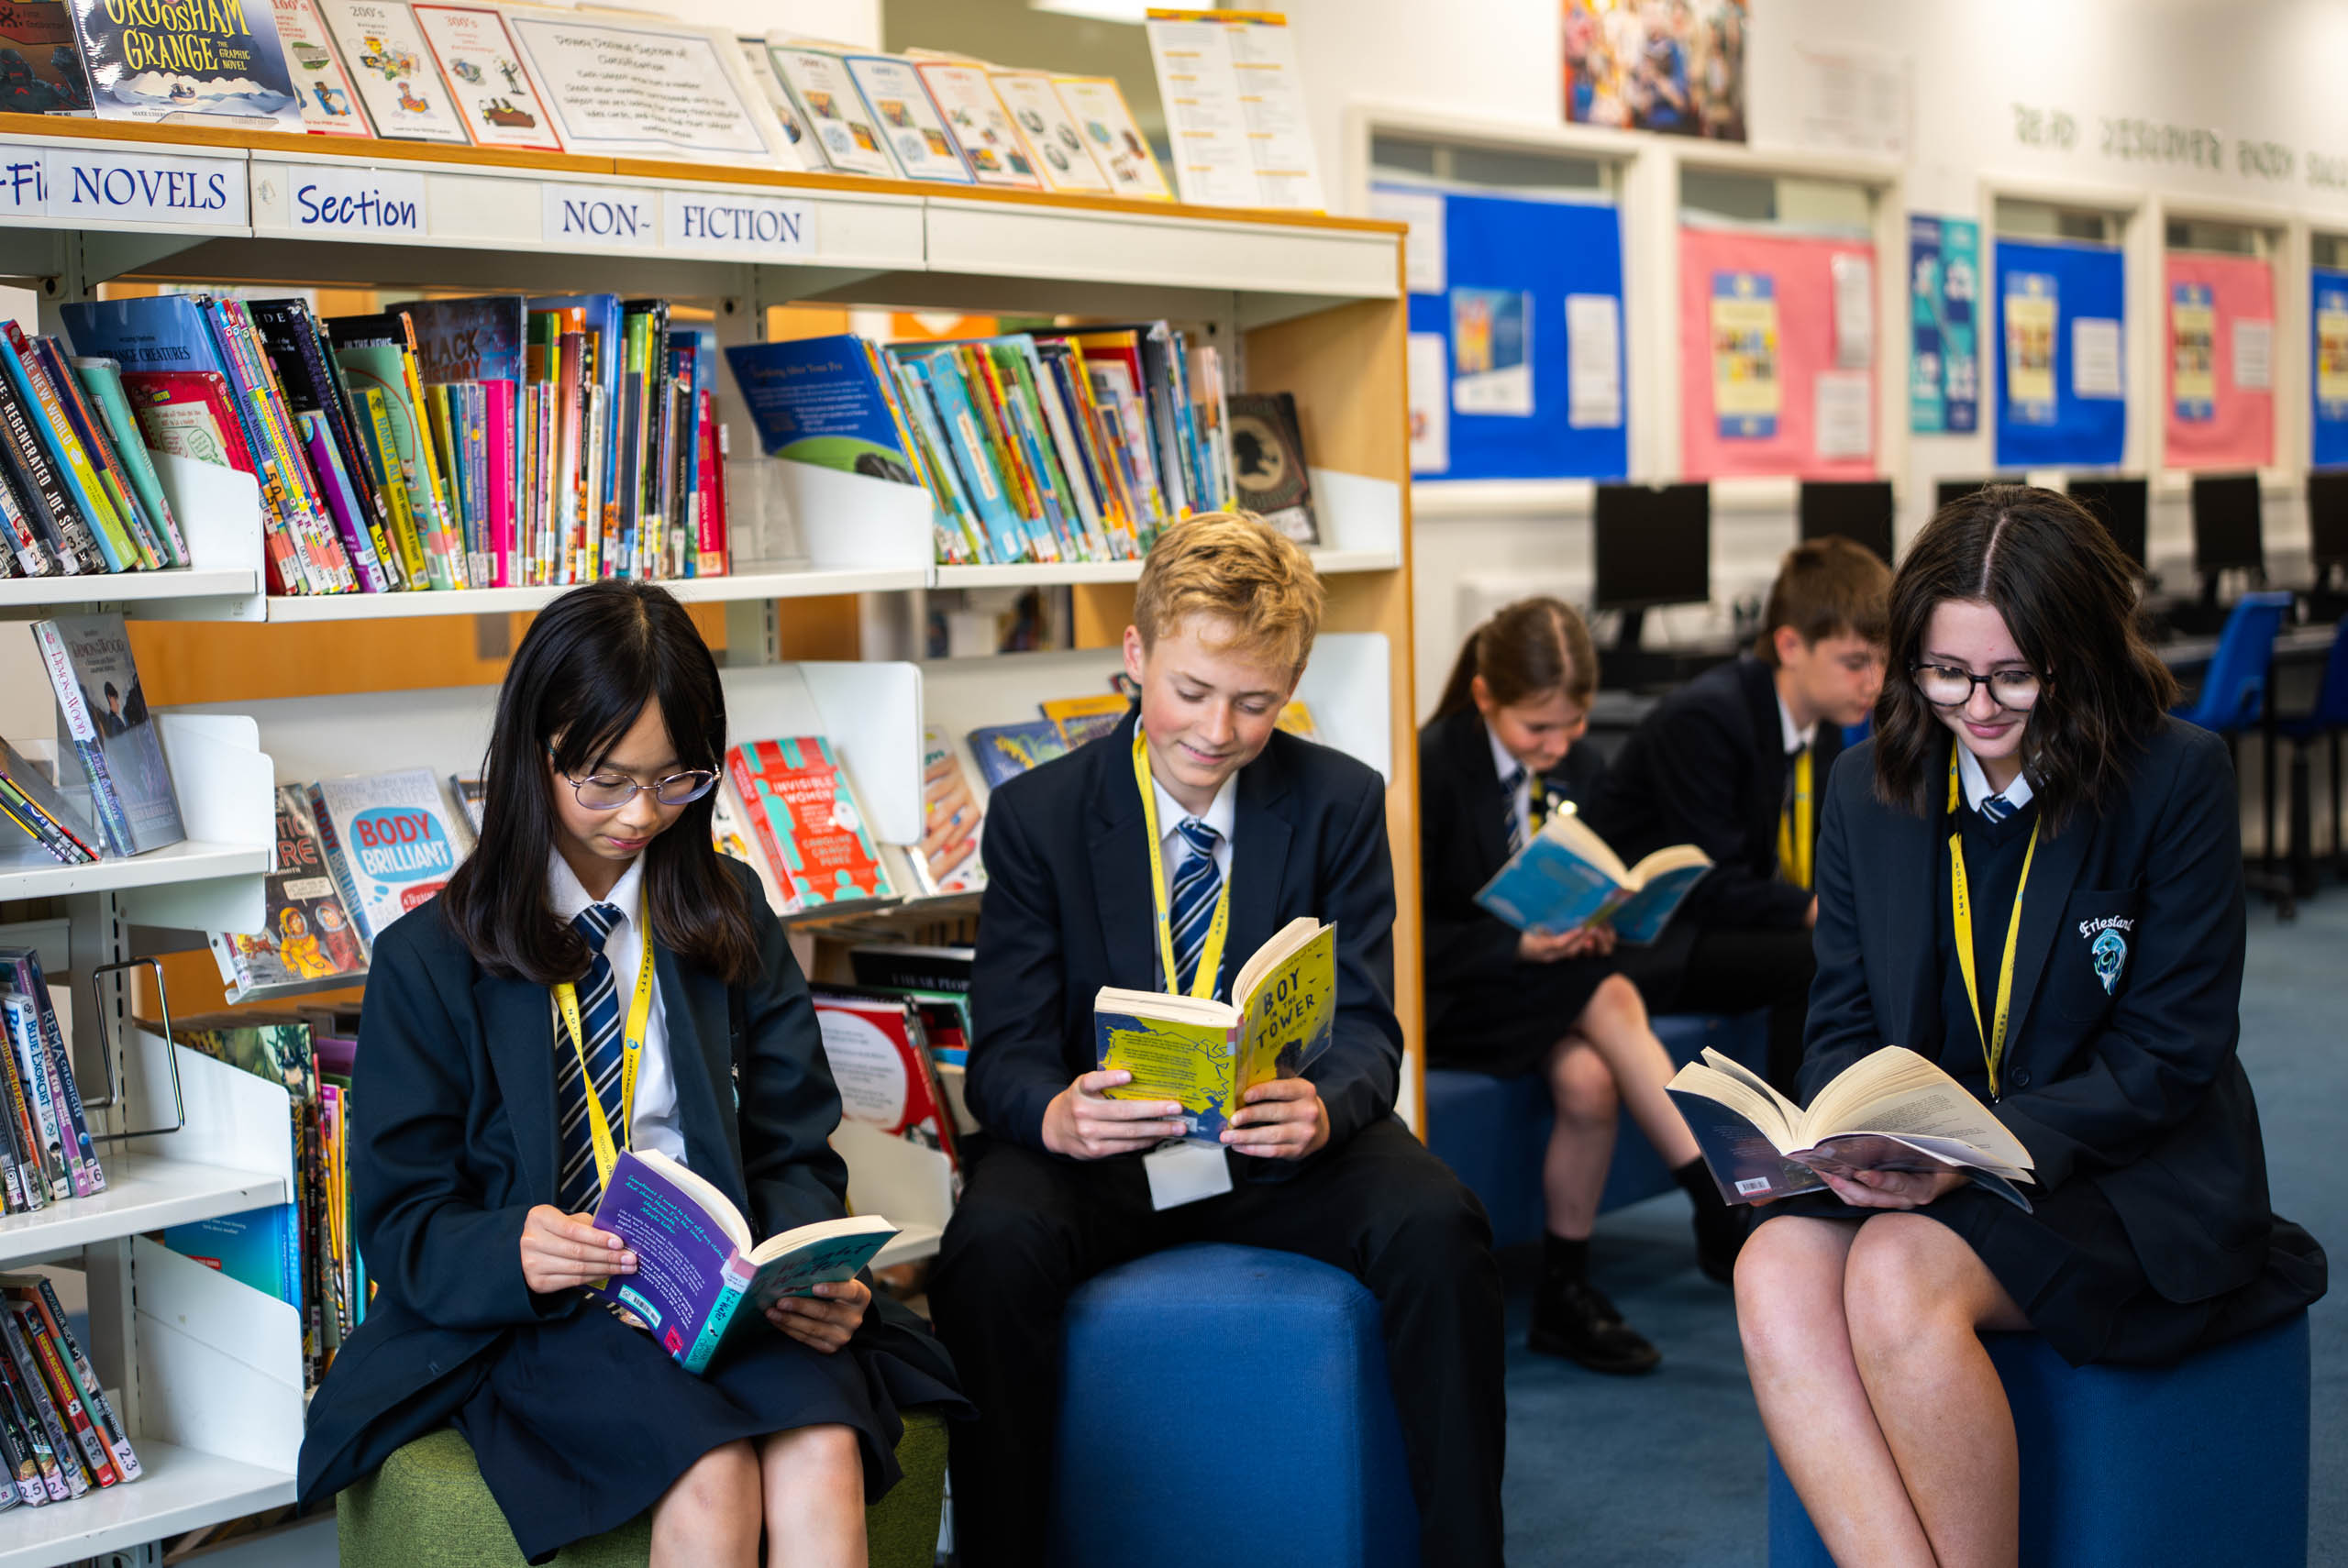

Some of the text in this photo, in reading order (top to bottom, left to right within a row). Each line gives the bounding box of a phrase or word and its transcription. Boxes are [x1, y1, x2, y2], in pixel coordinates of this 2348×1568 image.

[123, 28, 218, 72] GRANGE
[219, 49, 250, 61] GRAPHIC
[223, 59, 248, 71] NOVEL
[71, 166, 227, 210] NOVELS
[298, 184, 416, 229] Section
[683, 205, 802, 243] FICTION
[139, 346, 191, 362] CREATURES
[29, 373, 51, 402] NEW
[45, 403, 73, 446] WORLD
[51, 386, 63, 403] TALK
[239, 394, 268, 456] GONE MISSING
[260, 400, 271, 419] HOW
[268, 420, 280, 440] DOES
[1, 402, 52, 486] REGENERATED
[44, 489, 65, 514] JOE
[373, 416, 403, 483] RAMLA ALI
[394, 487, 404, 502] NOT
[49, 650, 89, 735] DEMON WOOD
[772, 776, 836, 793] INVISIBLE
[784, 790, 832, 803] WOMEN
[356, 812, 433, 846] BODY
[311, 798, 364, 917] BODY BRILLIANT
[360, 841, 451, 877] BRILLIANT
[640, 939, 655, 995] HONESTY
[1264, 967, 1300, 1016] BOY
[1282, 995, 1297, 1009] THE
[1256, 993, 1315, 1049] TOWER
[23, 1020, 56, 1108] BLUE EXORCIST
[40, 1009, 83, 1119] REMA CHRONICLES
[49, 1073, 61, 1093] KID
[711, 1299, 732, 1323] Water
[116, 1446, 138, 1473] 2.3
[20, 1483, 42, 1498] 2.5
